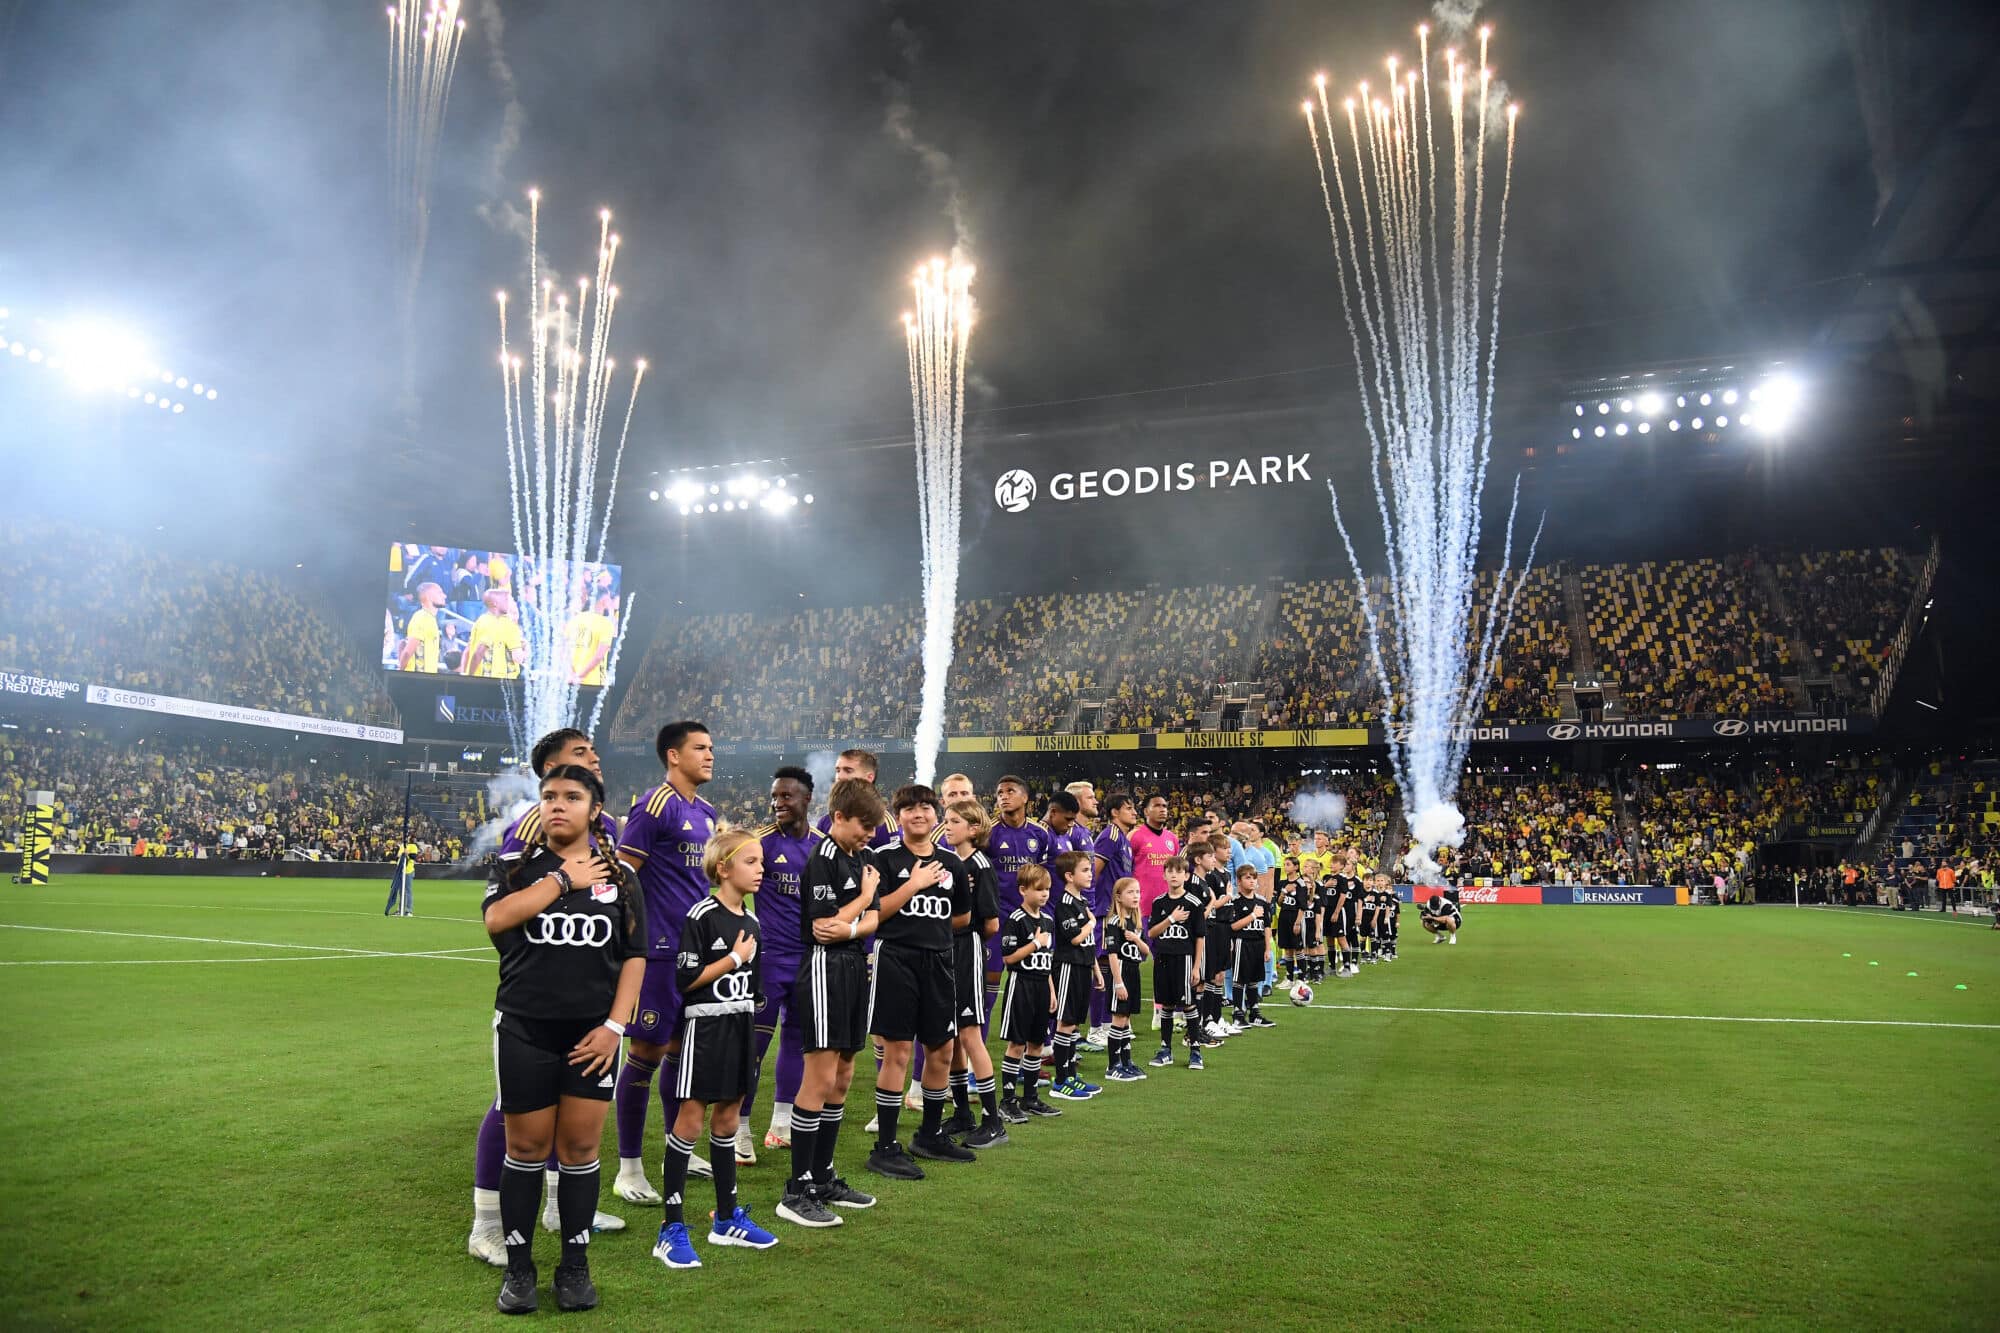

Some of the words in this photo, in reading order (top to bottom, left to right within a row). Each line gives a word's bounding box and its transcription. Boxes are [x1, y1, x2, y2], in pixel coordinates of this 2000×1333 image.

[1050, 462, 1195, 501] GEODIS
[1209, 453, 1312, 488] PARK
[6, 682, 28, 694] RED
[31, 686, 65, 699] GLARE
[20, 675, 80, 693] STREAMING
[114, 693, 156, 707] GEODIS
[219, 710, 239, 719] great
[1585, 723, 1673, 738] HYUNDAI
[1755, 718, 1847, 733] HYUNDAI
[369, 729, 398, 741] GEODIS
[1184, 732, 1245, 748] NASHVILLE
[1250, 731, 1264, 746] SC
[1035, 736, 1092, 750] NASHVILLE
[1096, 735, 1110, 750] SC
[678, 841, 704, 854] ORLA
[772, 871, 801, 883] ORLA
[777, 884, 801, 895] HEA
[1584, 892, 1644, 902] RENASANT
